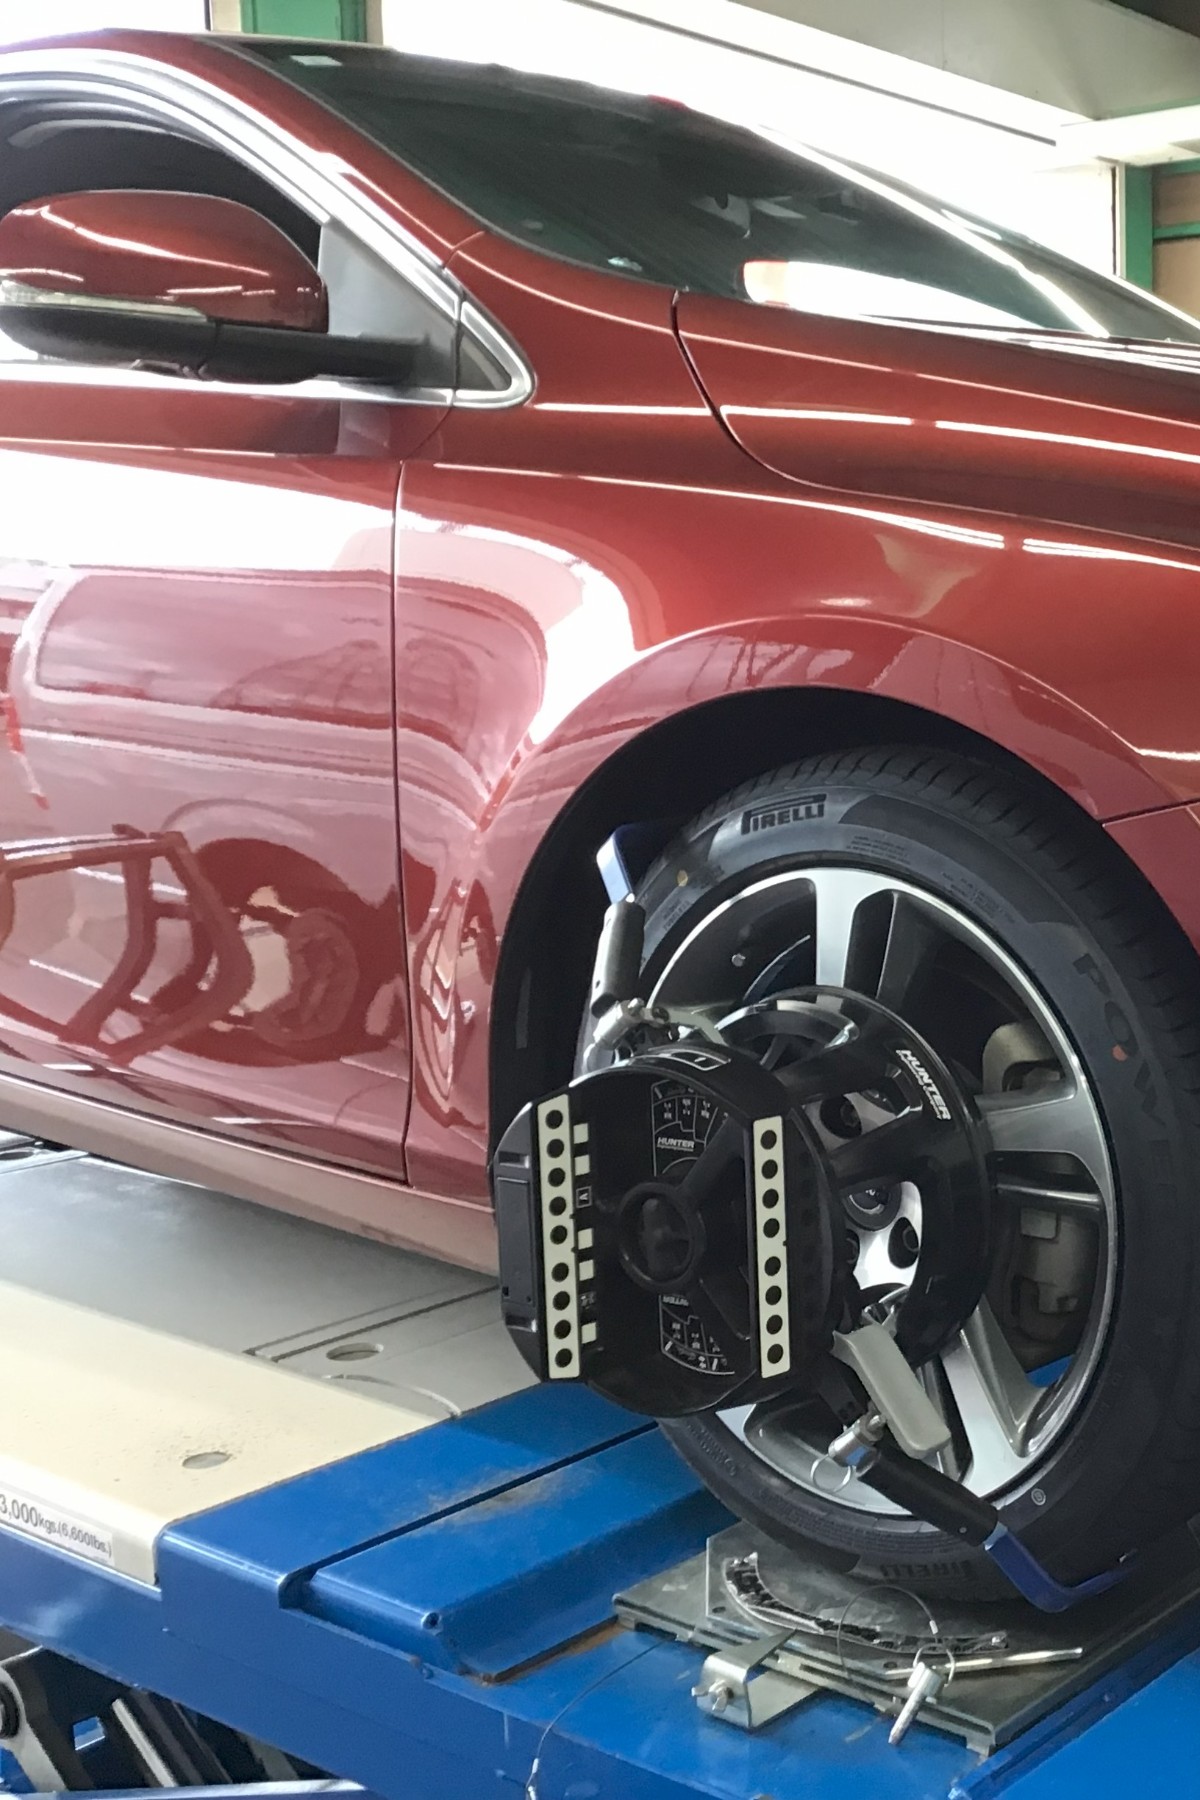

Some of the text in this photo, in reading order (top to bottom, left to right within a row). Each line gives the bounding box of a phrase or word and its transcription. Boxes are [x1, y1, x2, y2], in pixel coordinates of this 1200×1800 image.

[741, 794, 827, 835] PIRELLI
[901, 1050, 951, 1119] HUNTER
[657, 1137, 695, 1149] HUNTER
